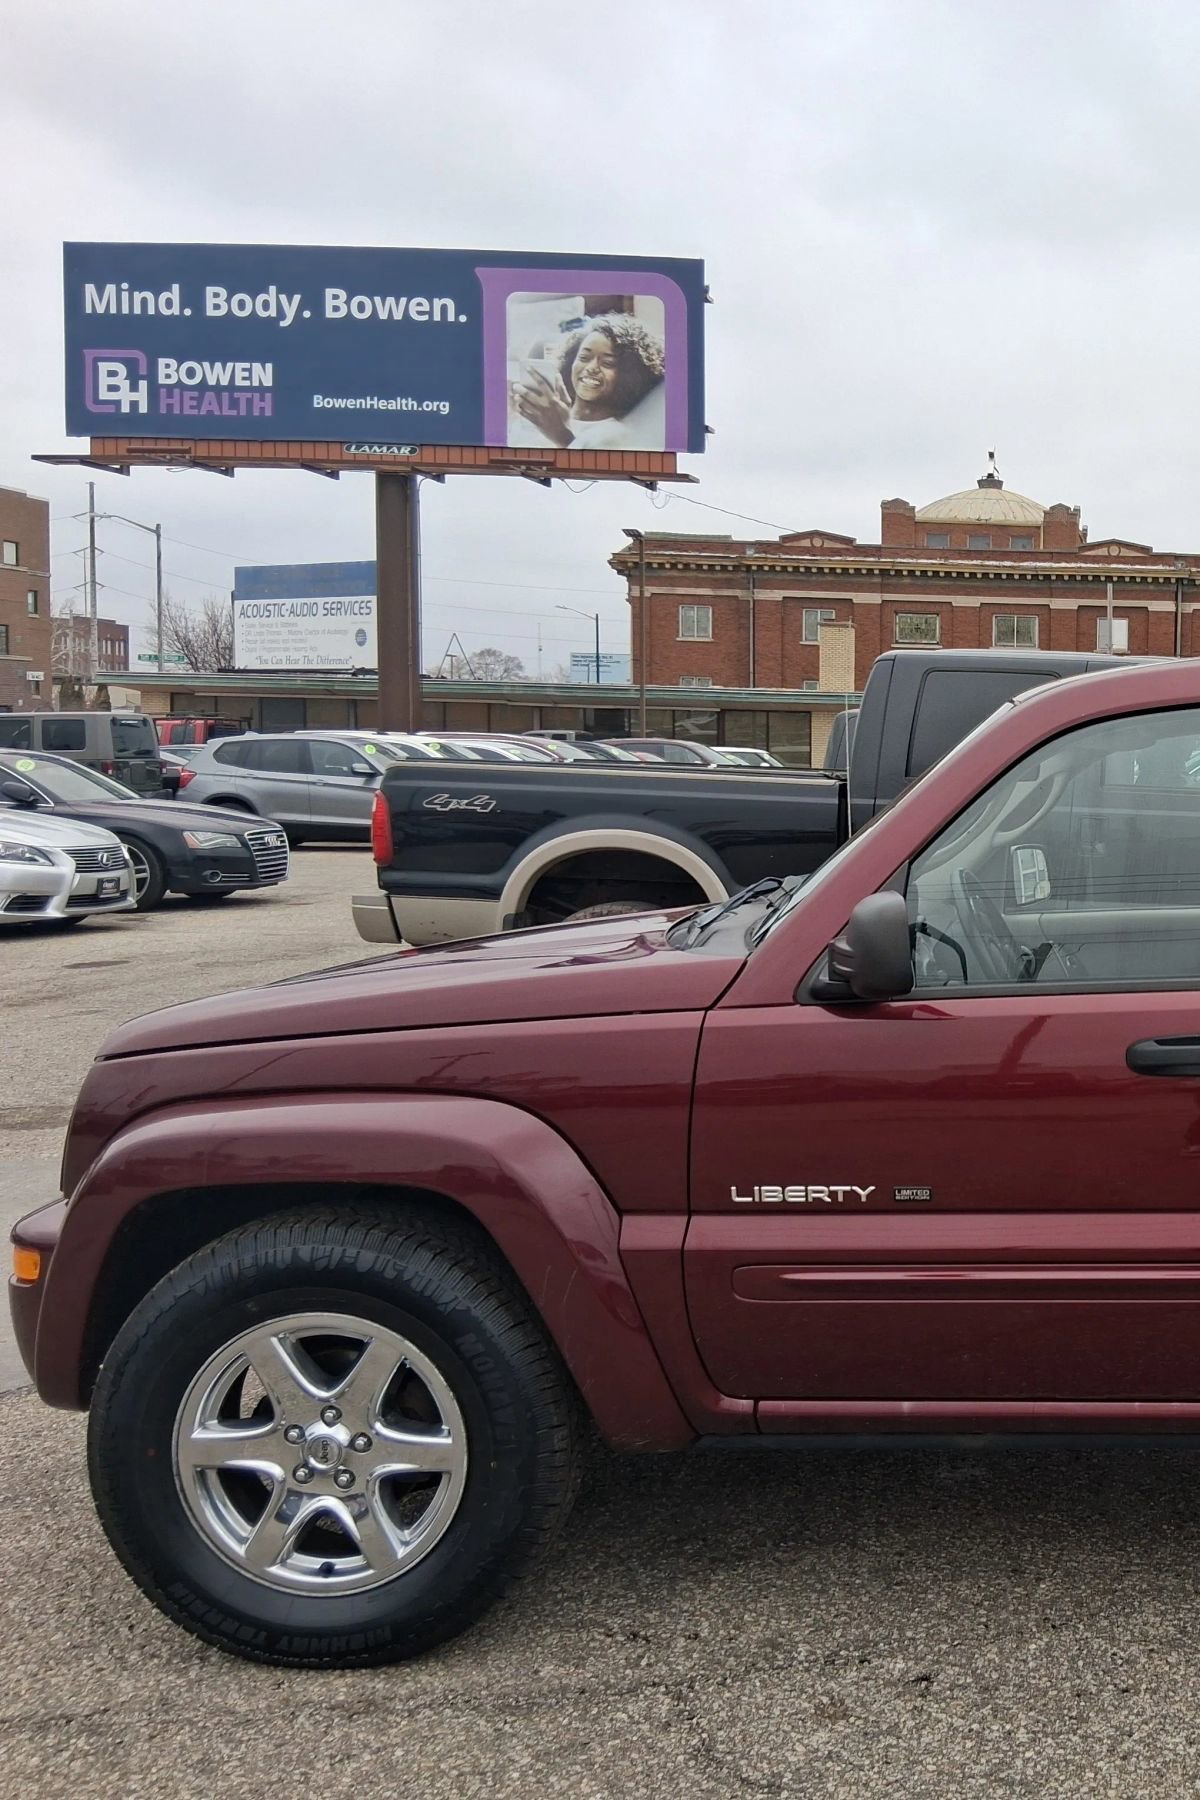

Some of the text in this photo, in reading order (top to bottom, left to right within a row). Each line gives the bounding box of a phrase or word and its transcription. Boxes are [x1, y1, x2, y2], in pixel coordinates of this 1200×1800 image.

[84, 282, 467, 327] Mind. Body. Bowen.
[157, 358, 273, 386] BOWEN
[159, 388, 272, 416] HEALTH
[313, 395, 450, 414] BowenHealth.org
[350, 444, 411, 455] LAMAR
[323, 600, 372, 617] SERVICES
[271, 656, 282, 666] Can
[285, 655, 300, 666] Hear
[303, 655, 314, 666] The
[422, 793, 497, 812] 4x4
[730, 1186, 876, 1202] LIBERTY
